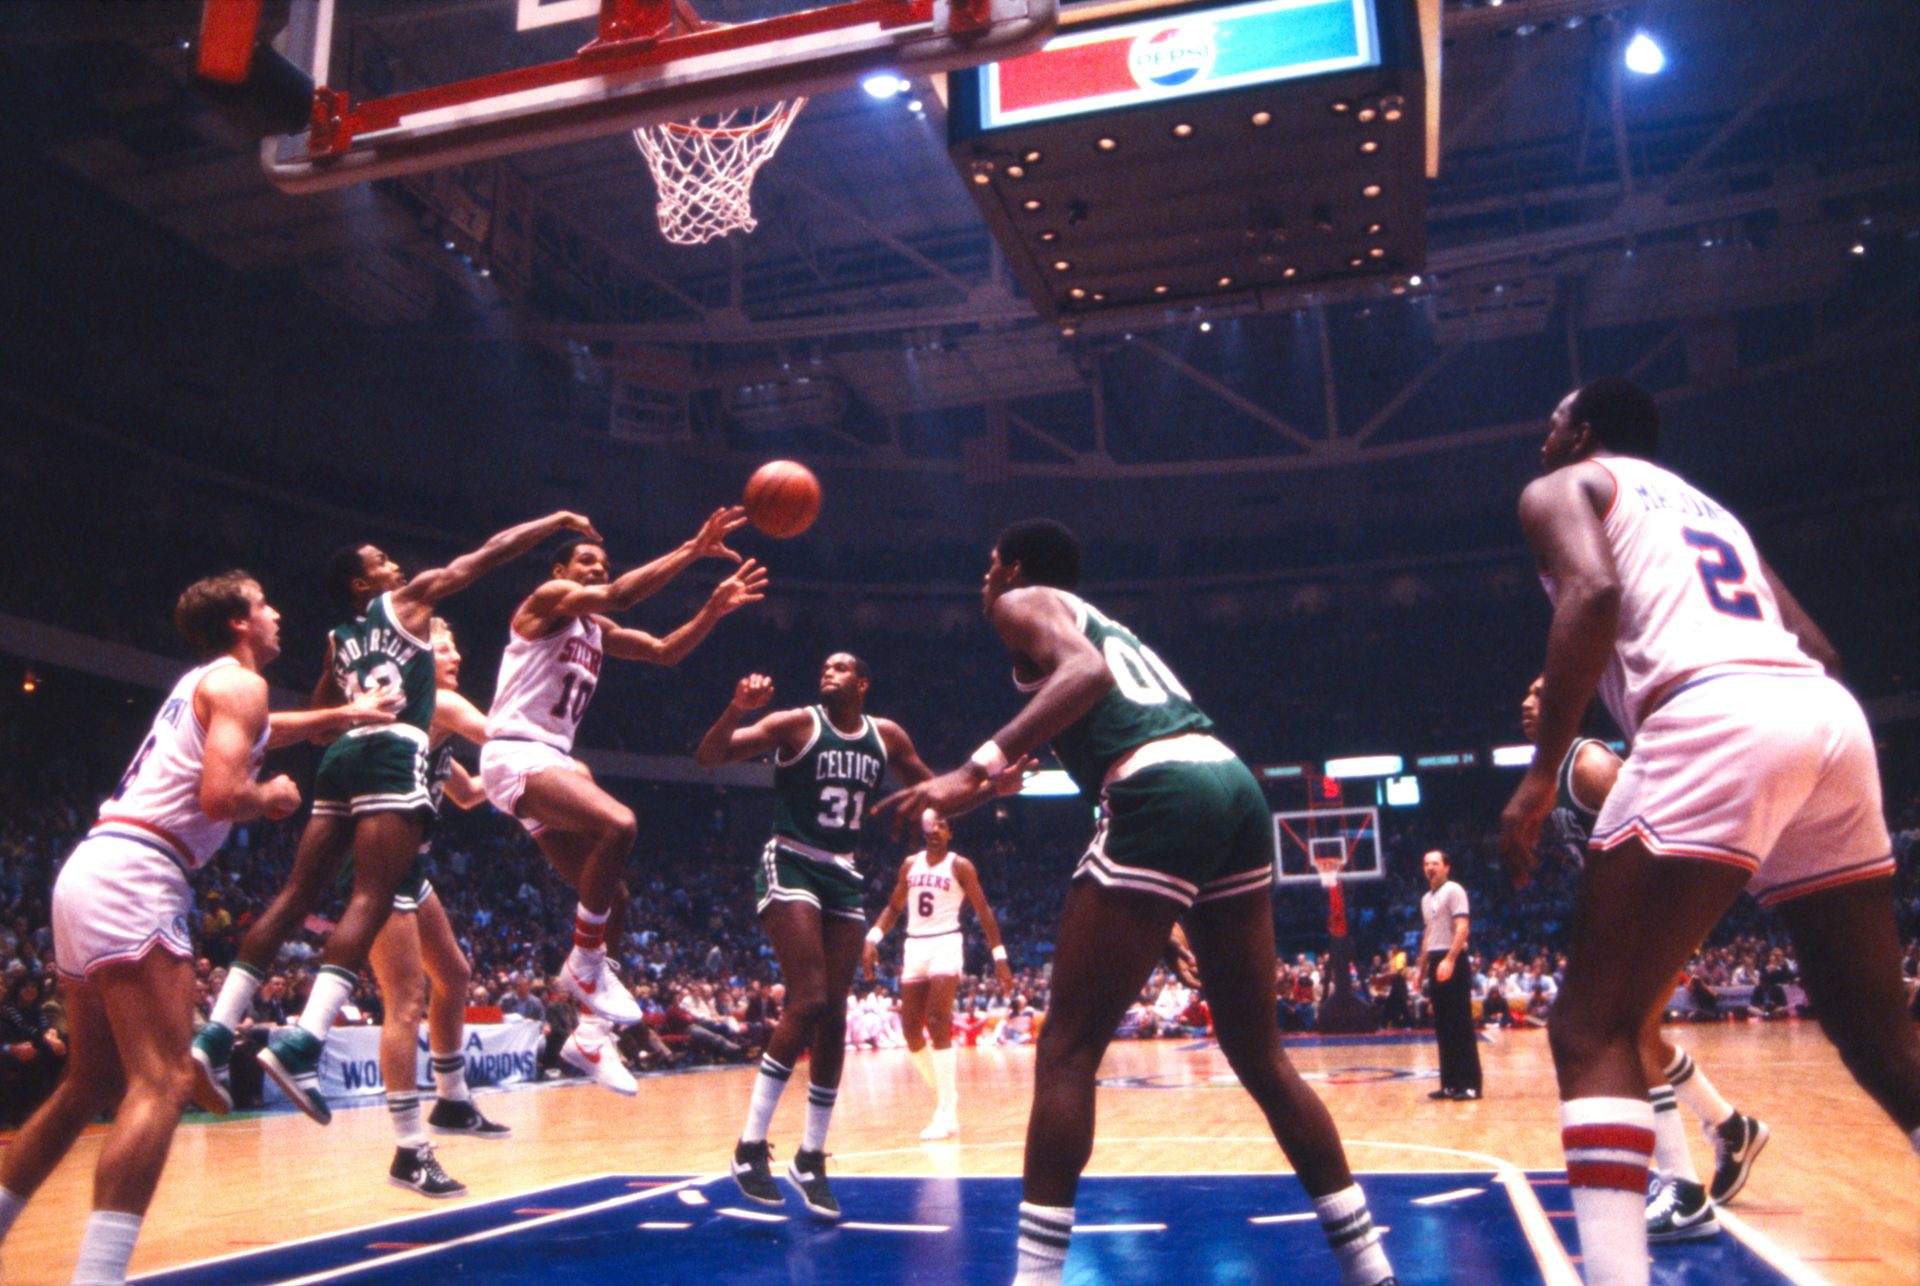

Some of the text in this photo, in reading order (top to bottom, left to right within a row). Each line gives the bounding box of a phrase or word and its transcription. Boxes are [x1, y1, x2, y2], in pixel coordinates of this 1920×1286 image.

[1137, 45, 1210, 66] PEPSI
[1680, 525, 1764, 622] 2
[550, 672, 594, 726] 10
[816, 750, 881, 788] CELTICS
[817, 786, 866, 830] 31
[918, 891, 935, 918] 6
